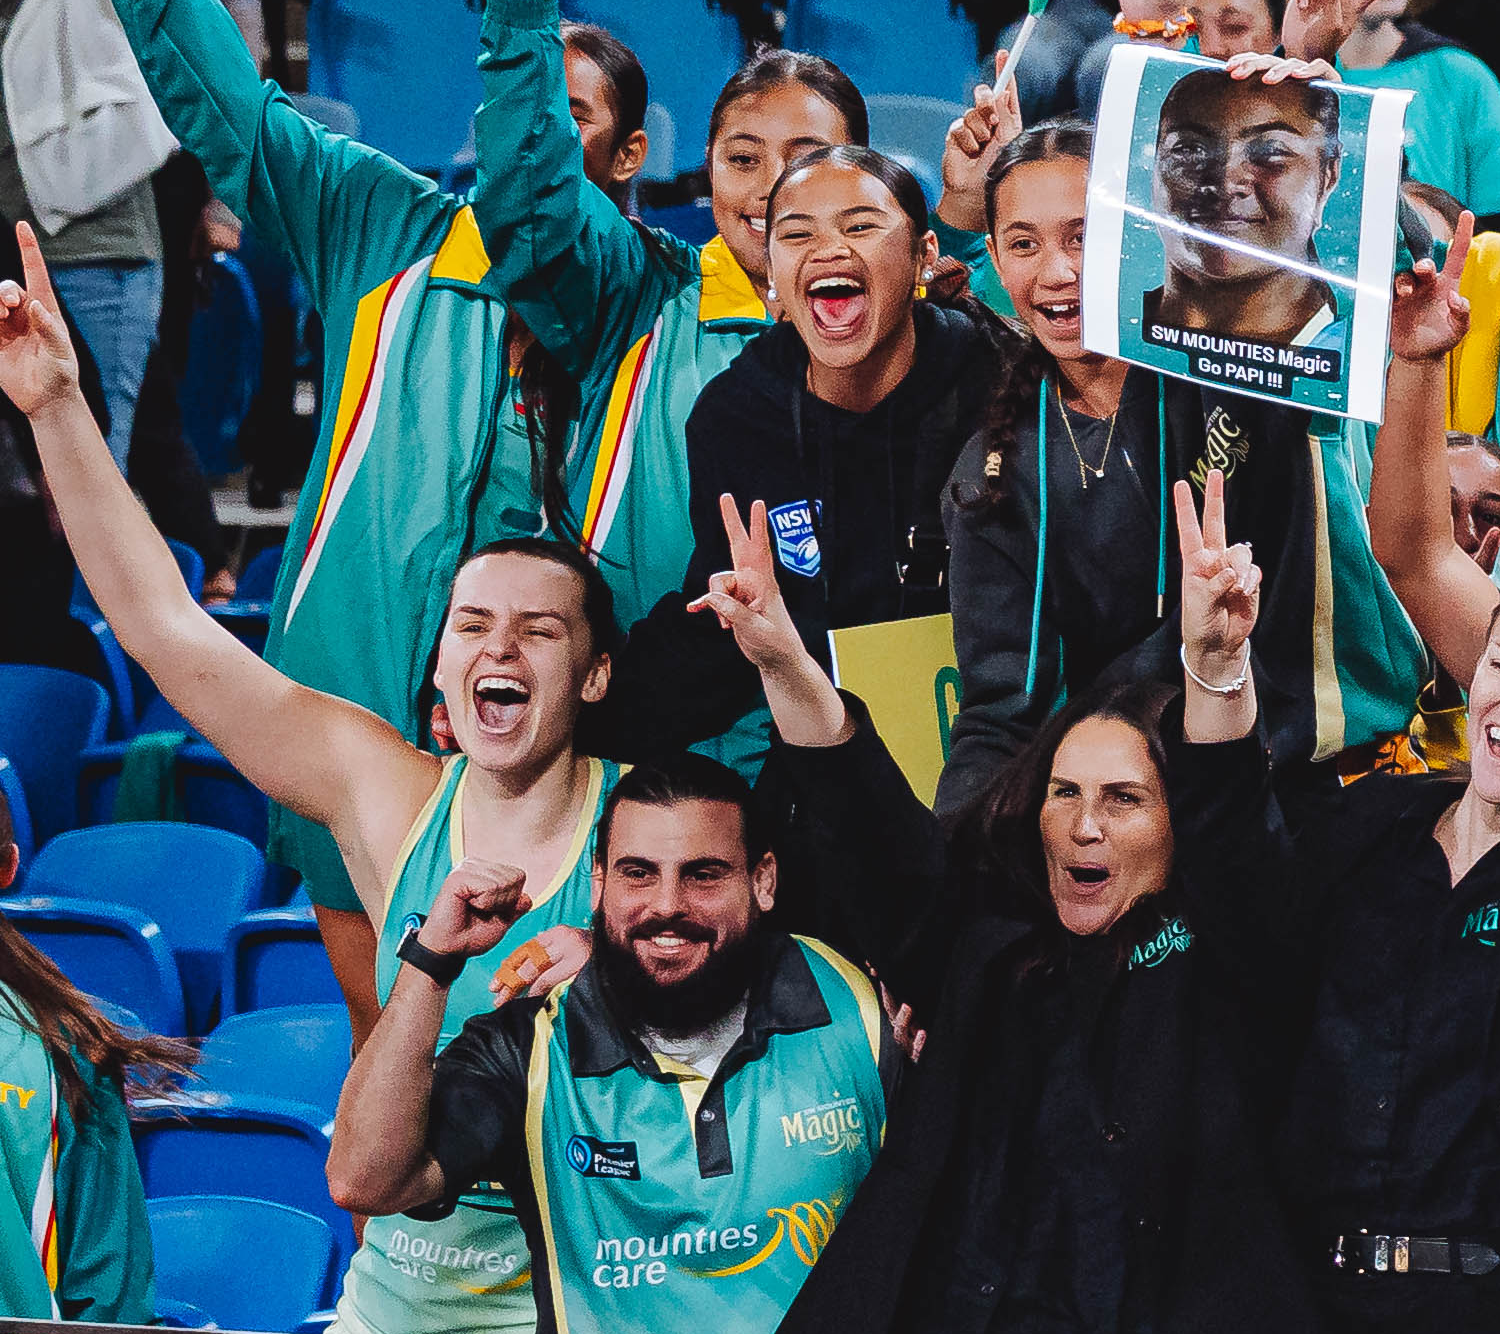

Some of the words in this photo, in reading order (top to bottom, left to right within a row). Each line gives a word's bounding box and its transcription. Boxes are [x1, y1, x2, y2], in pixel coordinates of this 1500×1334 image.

[1151, 325, 1180, 344] SW
[1183, 332, 1275, 363] MOUNTIES
[1278, 350, 1331, 374] Magic
[1198, 358, 1222, 375] Go
[1226, 364, 1264, 385] PAPI
[1129, 919, 1187, 971] Magic
[781, 1105, 862, 1148] Magic
[391, 1229, 517, 1274] mounties
[595, 1224, 758, 1262] mounties
[592, 1261, 667, 1289] care
